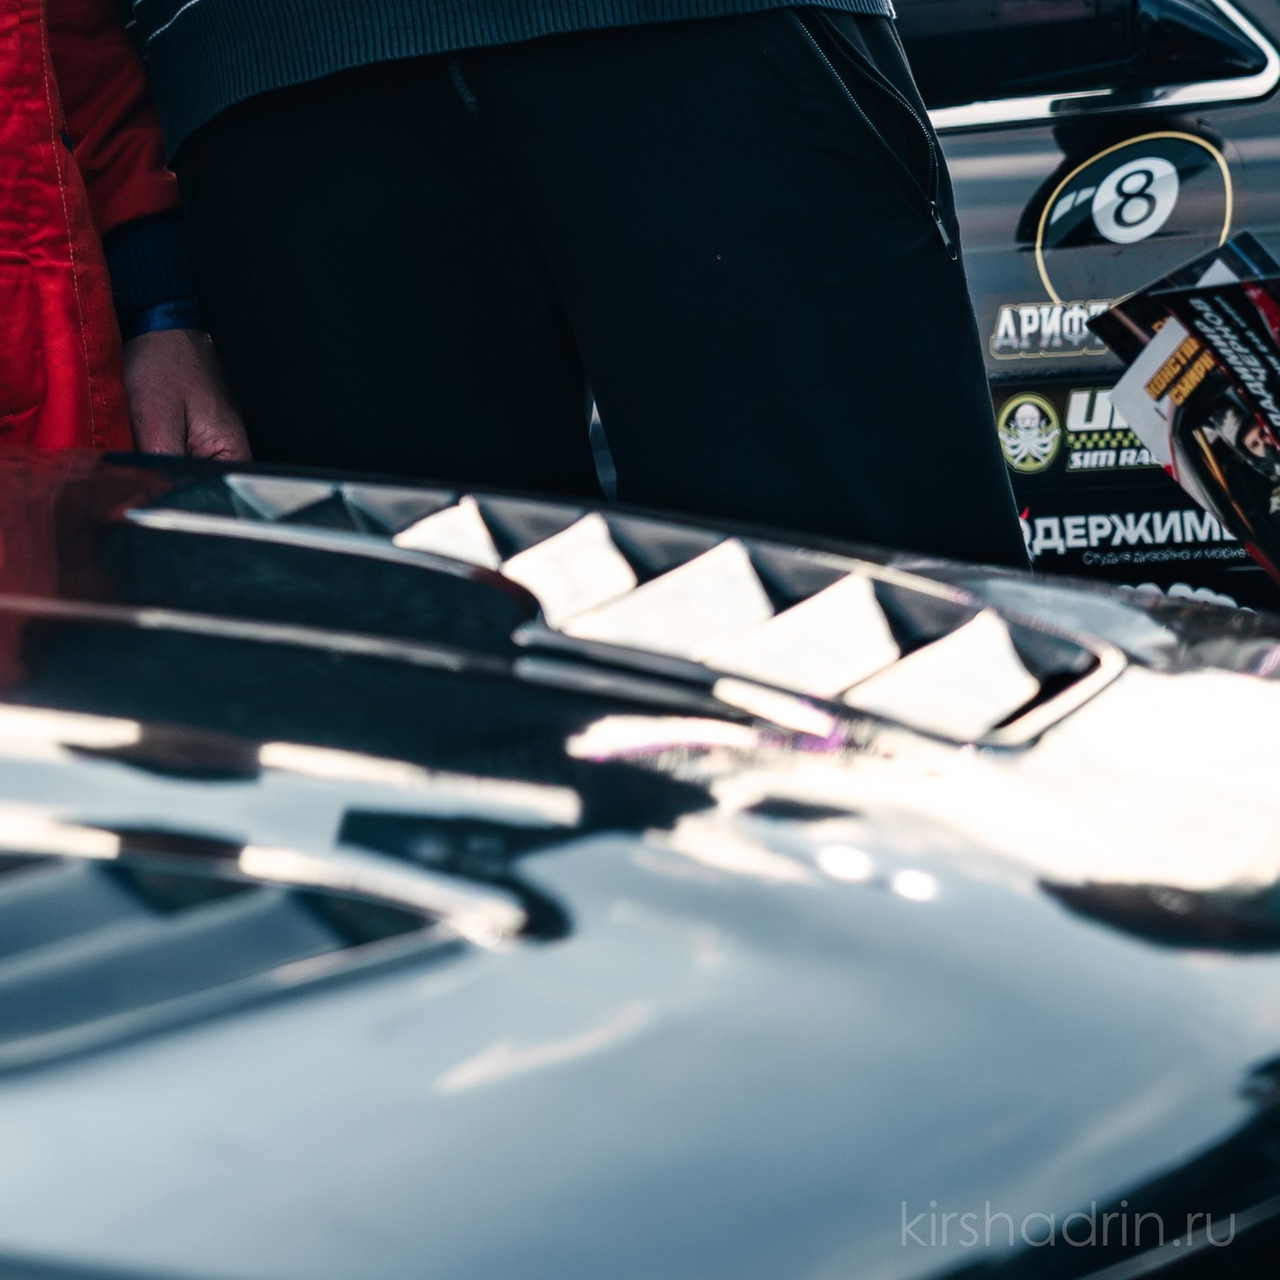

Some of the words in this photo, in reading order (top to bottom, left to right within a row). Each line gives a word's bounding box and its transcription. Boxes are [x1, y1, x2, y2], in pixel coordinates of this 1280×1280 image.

[1113, 169, 1156, 228] 8
[1119, 448, 1161, 467] RA
[1019, 509, 1238, 558] ДЕРЖИМ
